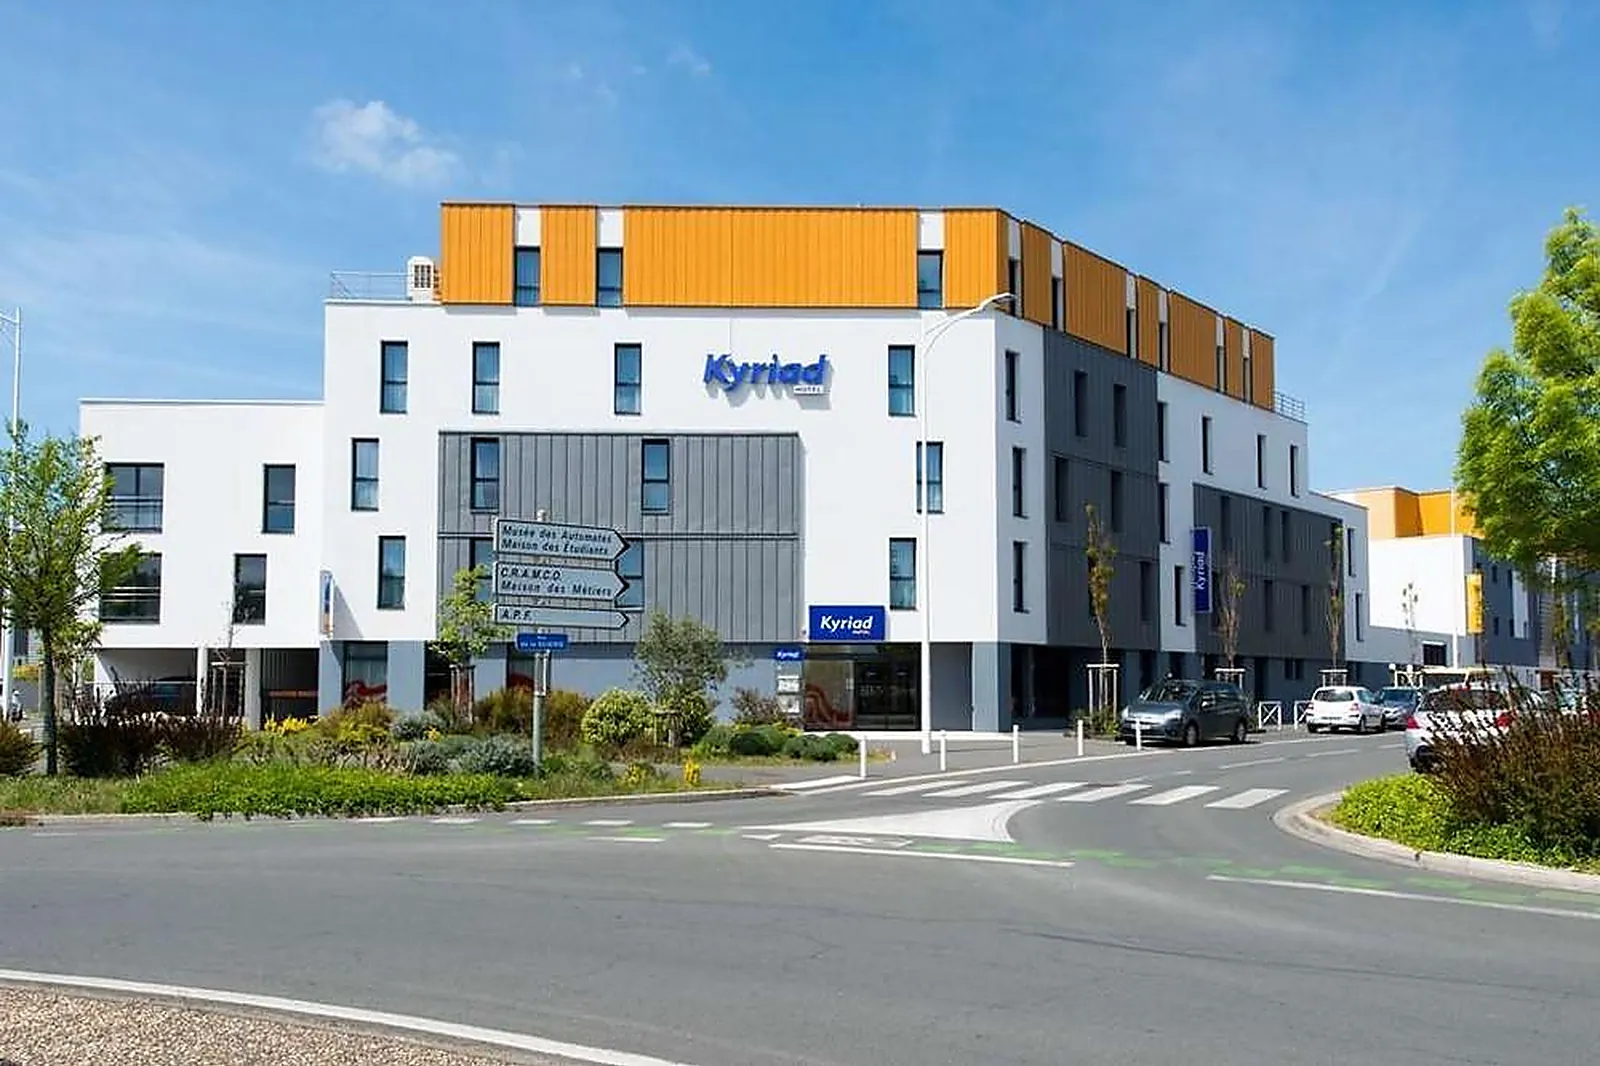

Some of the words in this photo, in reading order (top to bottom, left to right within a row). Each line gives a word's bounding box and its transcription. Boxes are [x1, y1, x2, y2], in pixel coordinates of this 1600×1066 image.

[703, 354, 828, 392] Kyriad
[540, 529, 558, 539] des
[502, 538, 538, 550] Maison
[542, 542, 559, 552] des
[1194, 551, 1206, 590] Kyriad
[501, 580, 540, 592] Maison
[547, 583, 565, 594] des
[572, 584, 612, 597] Métiers
[820, 615, 873, 632] Kyriad
